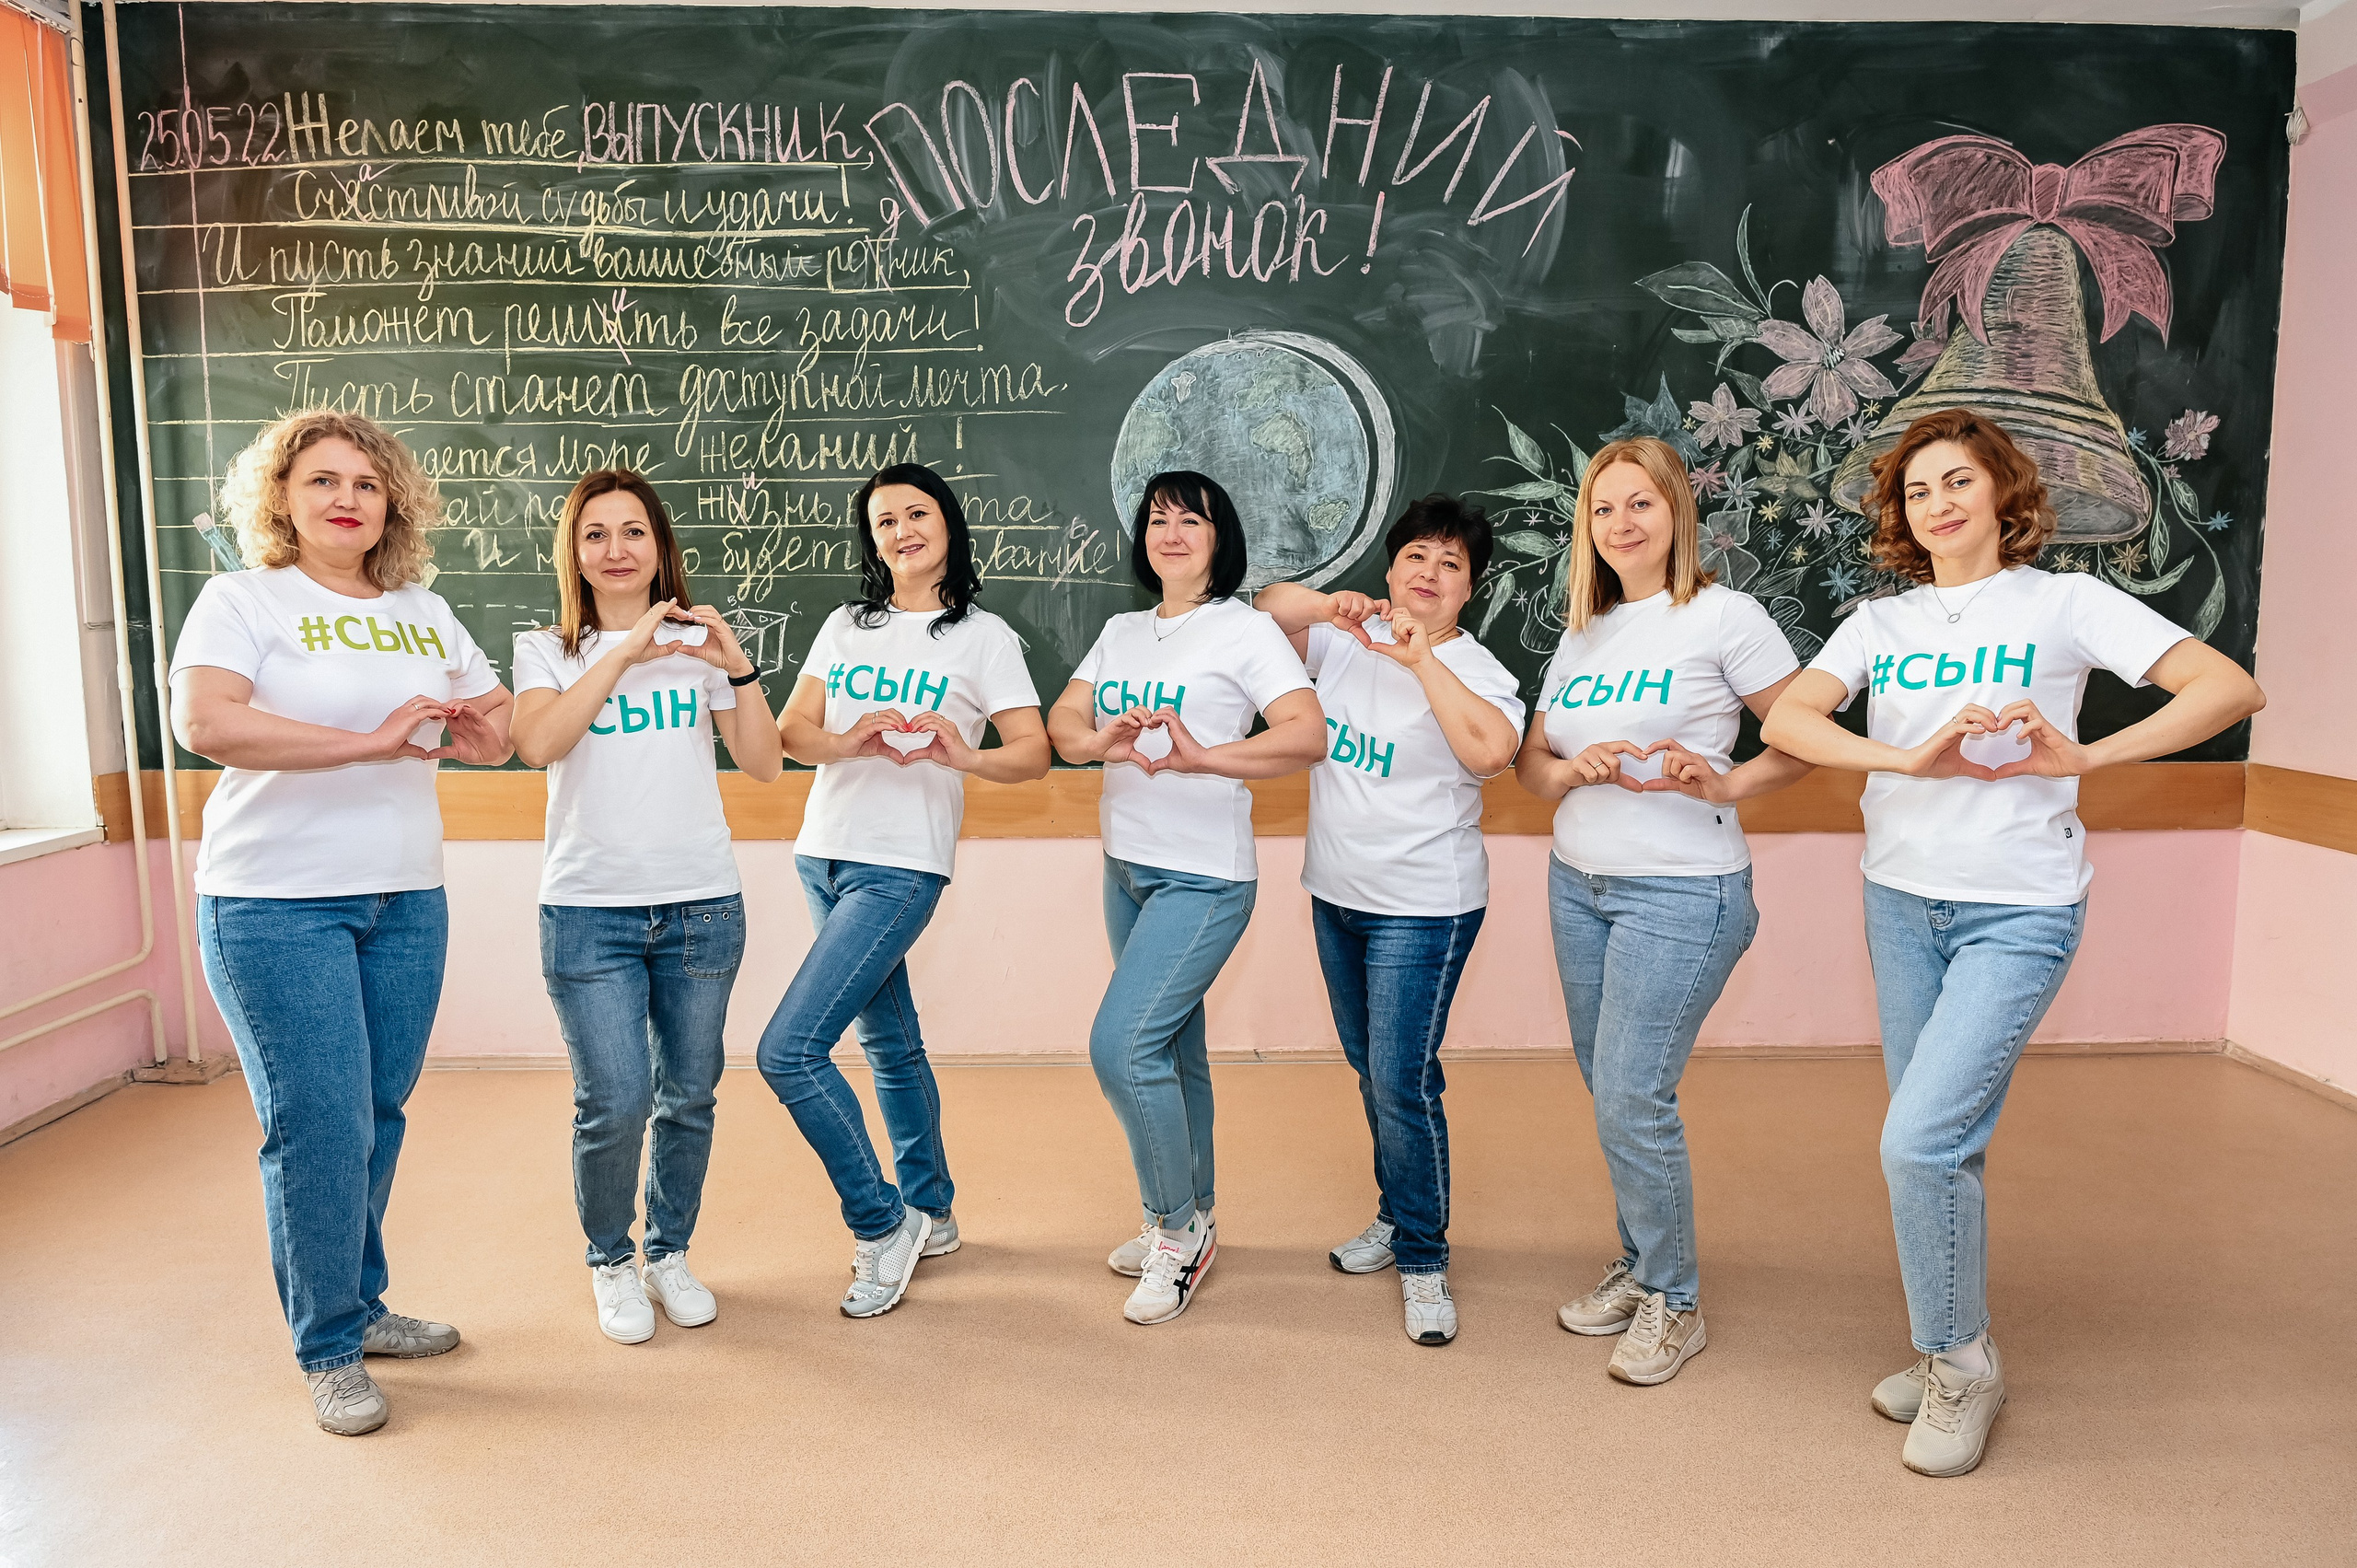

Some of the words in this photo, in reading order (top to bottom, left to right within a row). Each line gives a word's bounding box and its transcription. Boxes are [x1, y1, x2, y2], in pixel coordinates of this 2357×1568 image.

[284, 91, 465, 163] Желаем
[865, 58, 1582, 257] ПОСЛЕДНИЙ
[541, 179, 659, 258] судьбы
[663, 190, 703, 225] и
[703, 165, 856, 259] удачи!
[203, 223, 261, 285] И
[271, 238, 399, 308] пусть
[406, 238, 584, 302] знаний
[720, 295, 784, 346] все
[795, 294, 984, 377] задачи!
[273, 357, 434, 418] Пусть
[451, 370, 669, 418] станет
[674, 363, 896, 457] доступной
[545, 435, 666, 477] море
[467, 528, 522, 571] И
[722, 530, 862, 602] будет
[297, 615, 447, 659] #СЫН
[1871, 643, 2036, 697] #СЫН
[587, 689, 697, 735] СЫН
[827, 662, 949, 711] #СЫН
